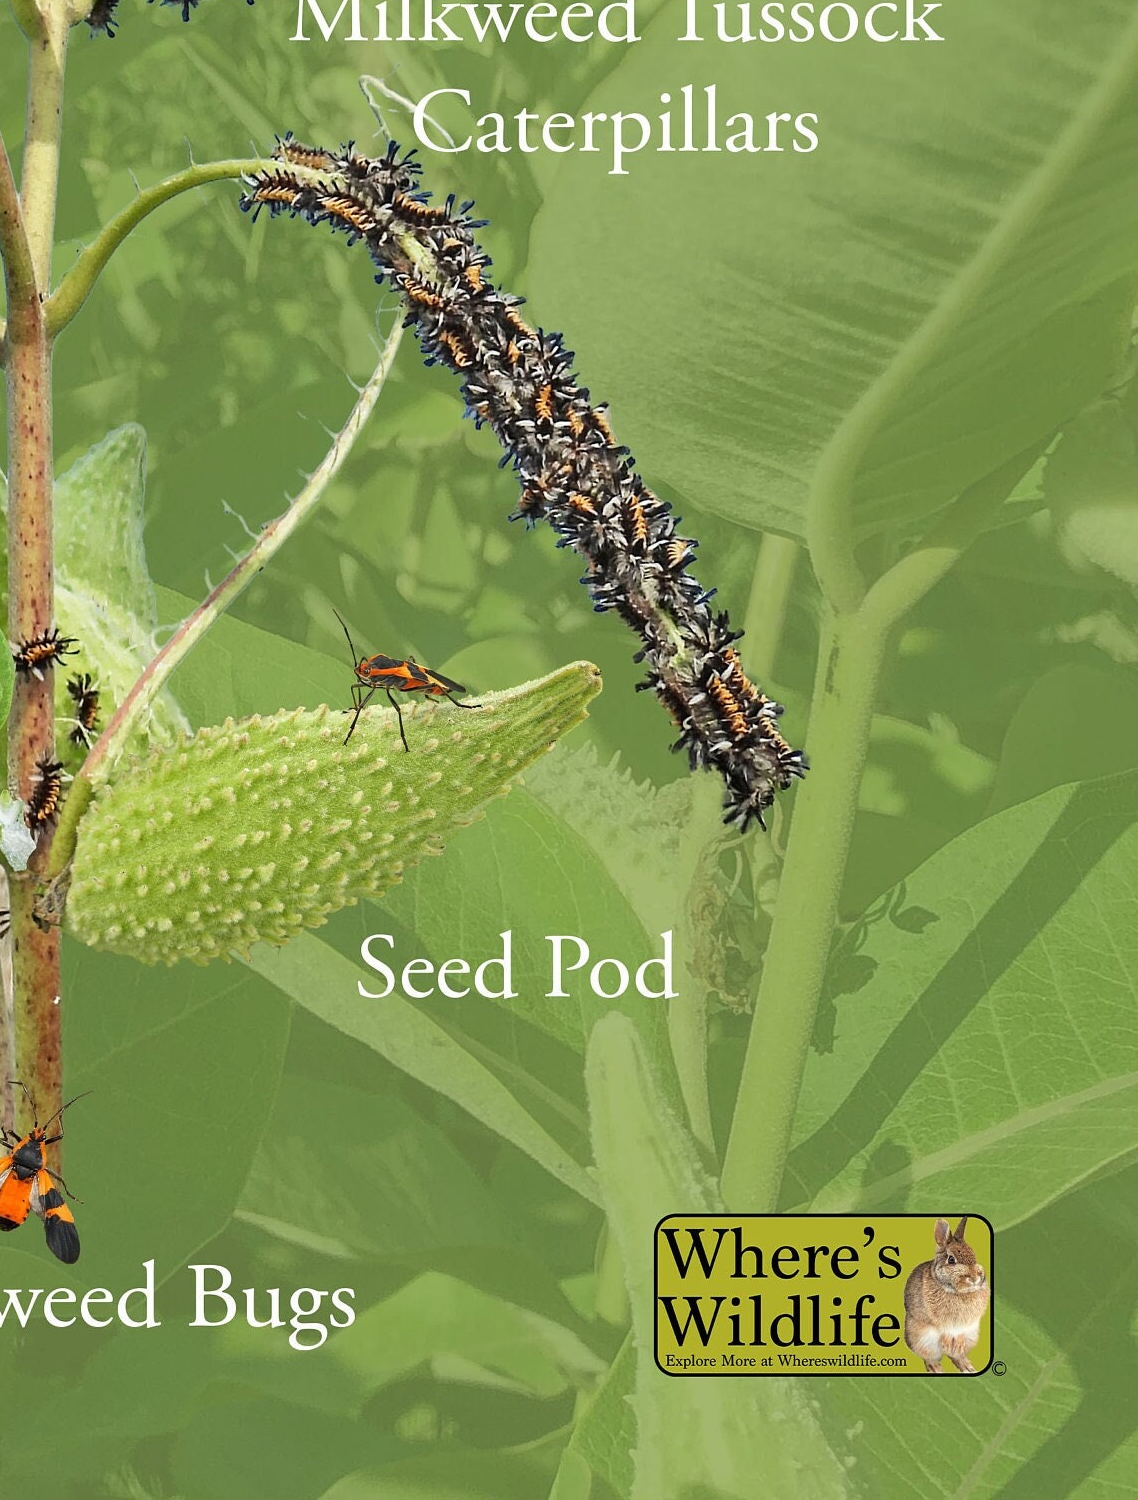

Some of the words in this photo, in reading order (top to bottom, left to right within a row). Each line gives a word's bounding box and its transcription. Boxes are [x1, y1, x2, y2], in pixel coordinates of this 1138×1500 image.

[408, 84, 819, 175] Caterpillars
[357, 930, 519, 999] Seed
[544, 930, 679, 999] Pod
[660, 1226, 902, 1279] Where's
[187, 1264, 356, 1351] Bugs
[658, 1294, 901, 1347] Wildlife
[665, 1354, 716, 1368] Explore
[722, 1354, 756, 1367] More
[761, 1355, 773, 1367] at
[778, 1354, 907, 1367] Whereswildlife.com
